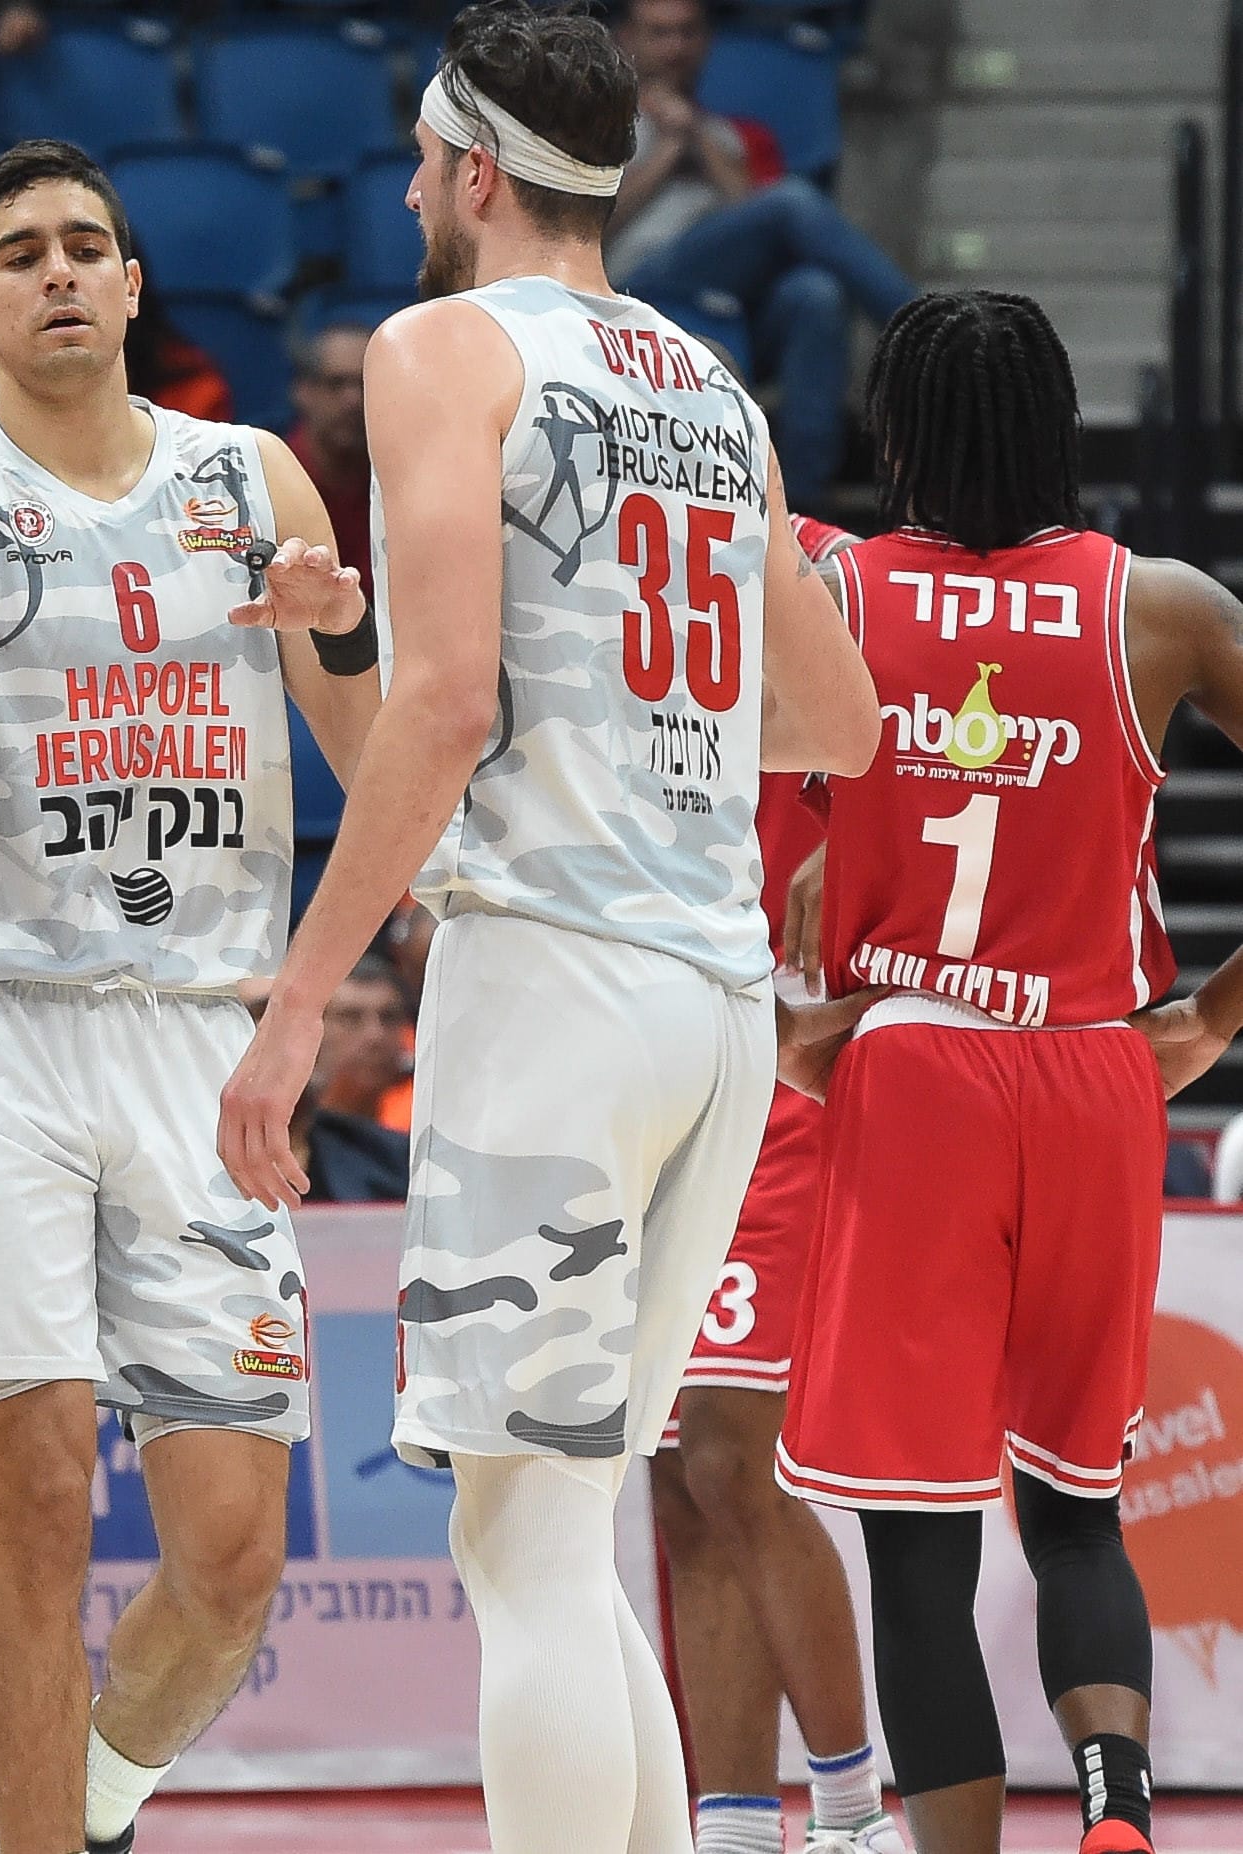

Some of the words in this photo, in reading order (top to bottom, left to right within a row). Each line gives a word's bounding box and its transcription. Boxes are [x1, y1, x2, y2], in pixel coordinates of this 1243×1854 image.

[592, 398, 748, 462] MIDTOWN
[597, 440, 752, 506] JERUSALEM
[112, 561, 161, 653] 6
[618, 493, 741, 712] 35
[889, 570, 1081, 641] בוקר
[66, 661, 229, 721] HAPOEL
[35, 723, 247, 788] JERUSALEM
[649, 710, 721, 782] ארומה
[922, 793, 1000, 961] 1
[702, 1261, 758, 1345] 3
[243, 1356, 292, 1374] Winner
